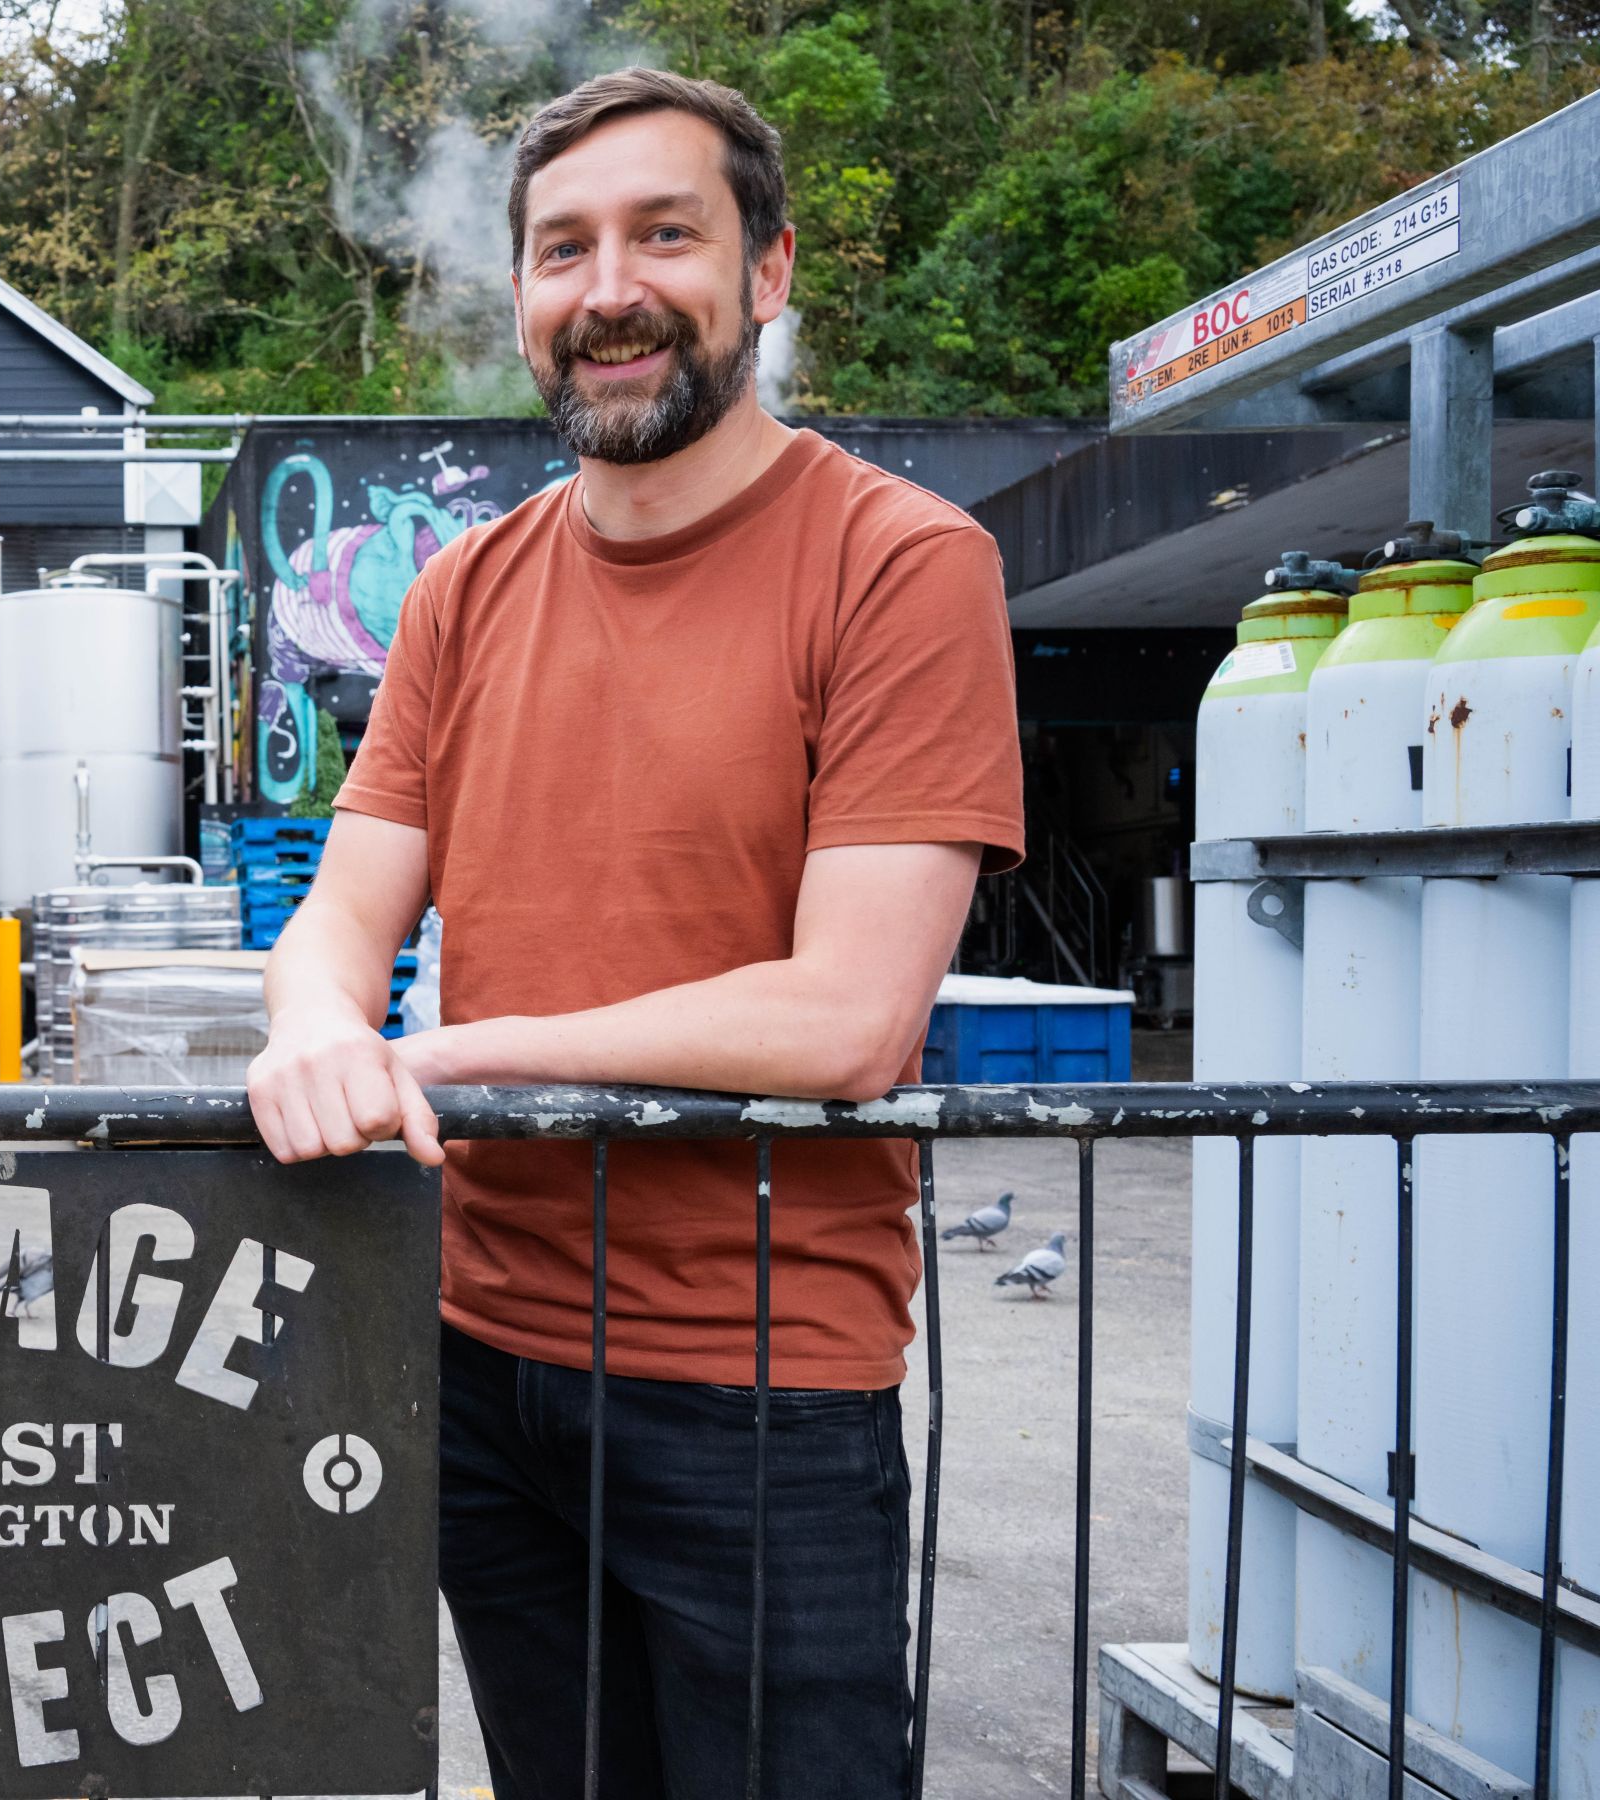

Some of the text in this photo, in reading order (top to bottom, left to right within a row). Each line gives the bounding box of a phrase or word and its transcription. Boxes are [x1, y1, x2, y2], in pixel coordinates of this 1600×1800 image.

[1311, 195, 1448, 278] GAS CODE: 214 G15
[1194, 290, 1249, 346] BOC
[1223, 334, 1239, 355] UN
[1266, 308, 1294, 334] 1013
[1189, 349, 1209, 371] 2RE
[2, 1423, 123, 1487] ST
